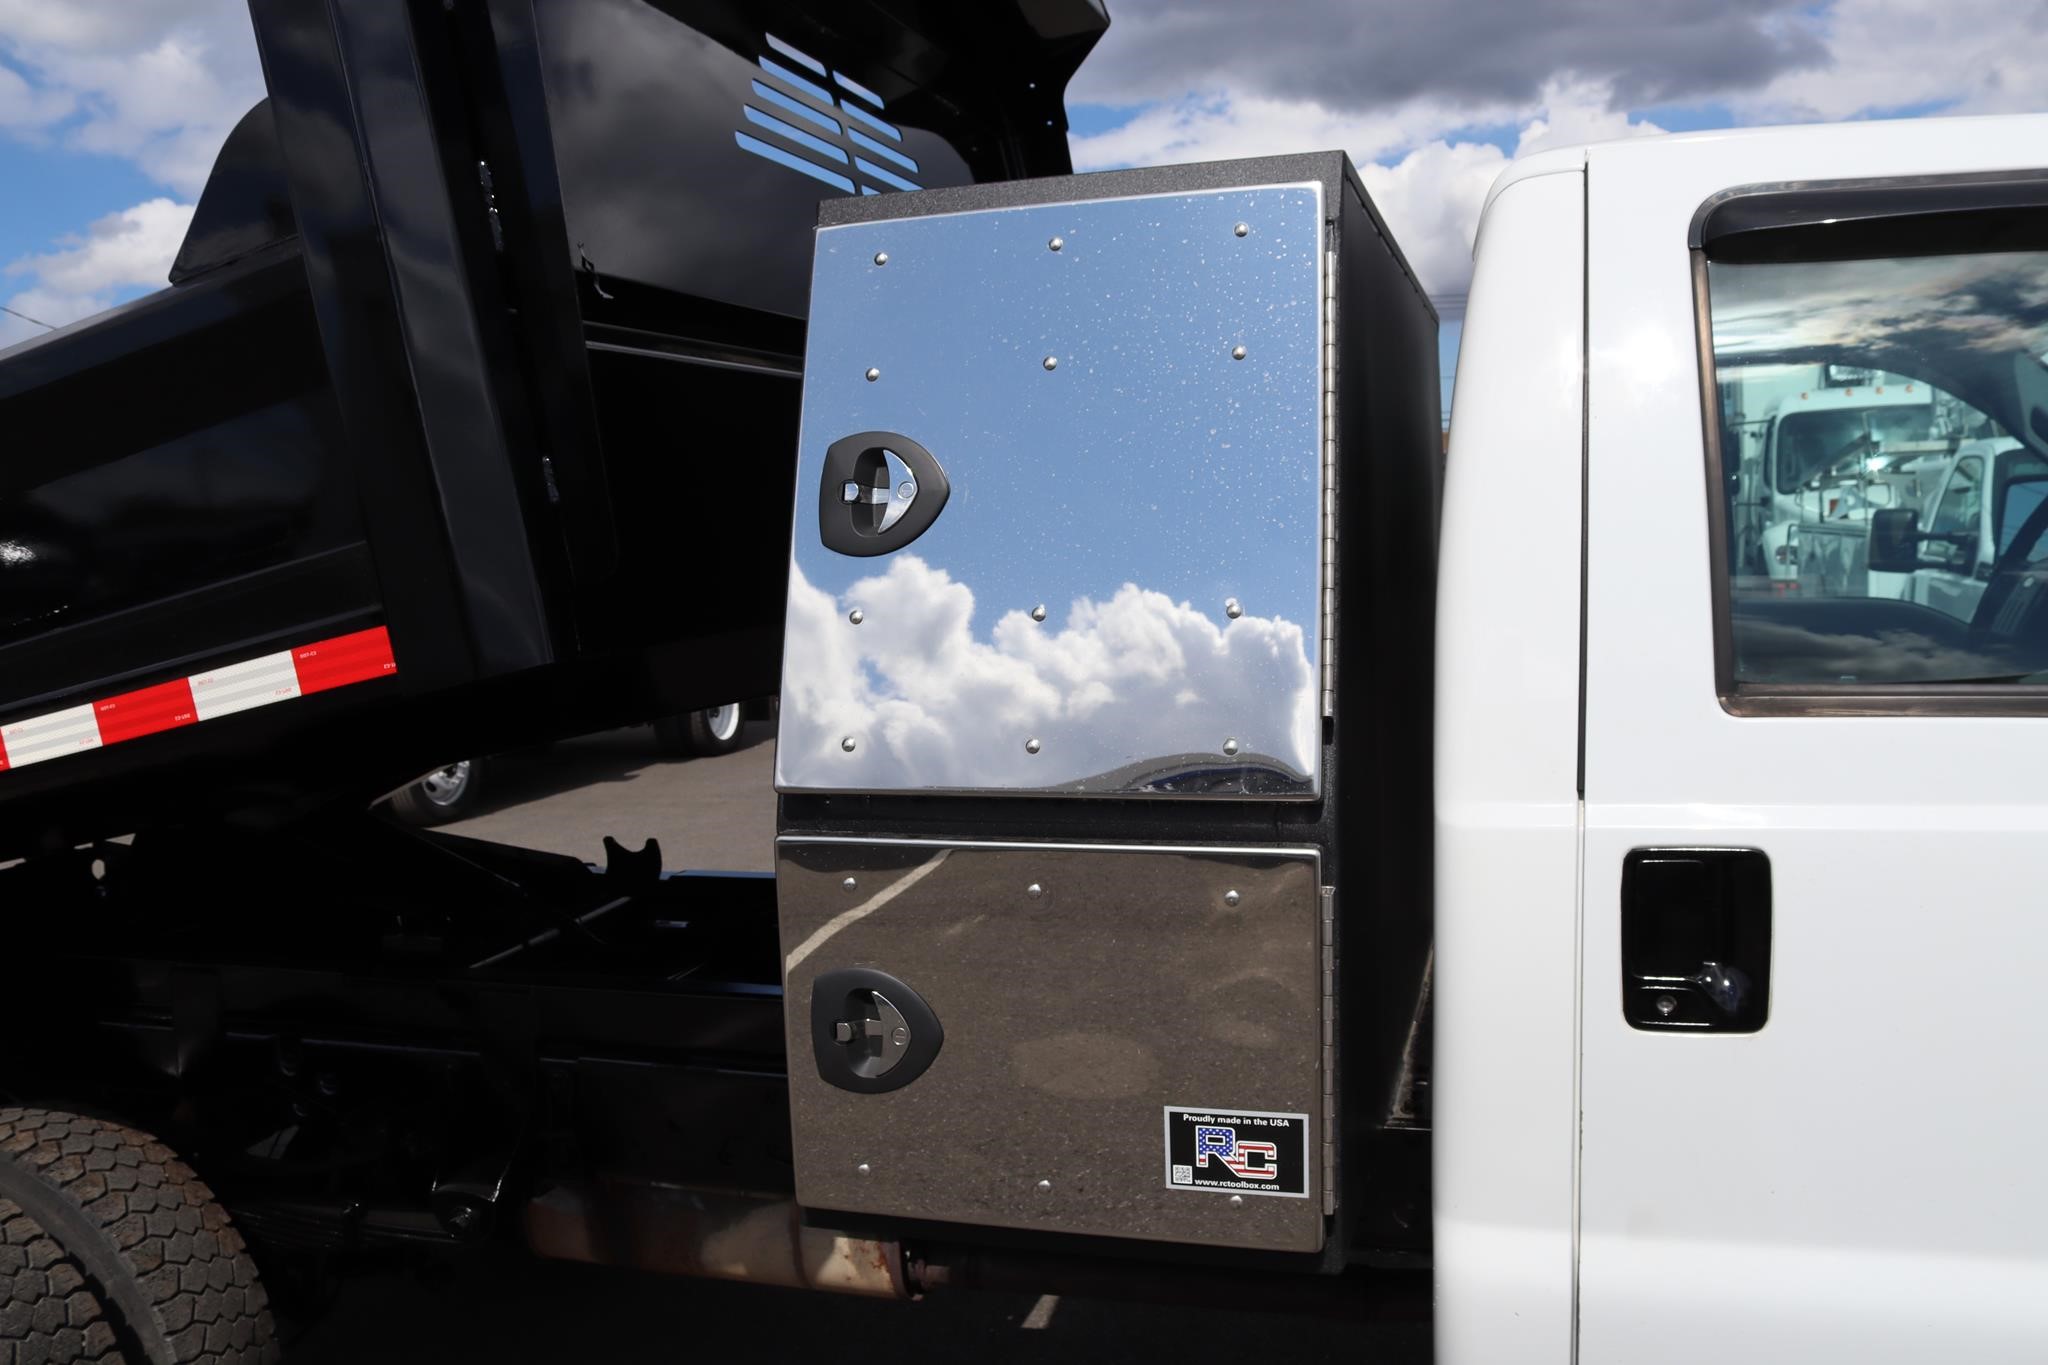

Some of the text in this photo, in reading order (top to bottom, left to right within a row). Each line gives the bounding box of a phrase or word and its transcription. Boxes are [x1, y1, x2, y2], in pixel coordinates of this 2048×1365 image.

[1183, 1113, 1216, 1125] Proudly
[1217, 1117, 1241, 1125] made
[1253, 1118, 1268, 1127] the
[1269, 1119, 1290, 1127] USA
[1195, 1125, 1277, 1180] RC
[1194, 1179, 1280, 1191] www.rctoolbox.com
